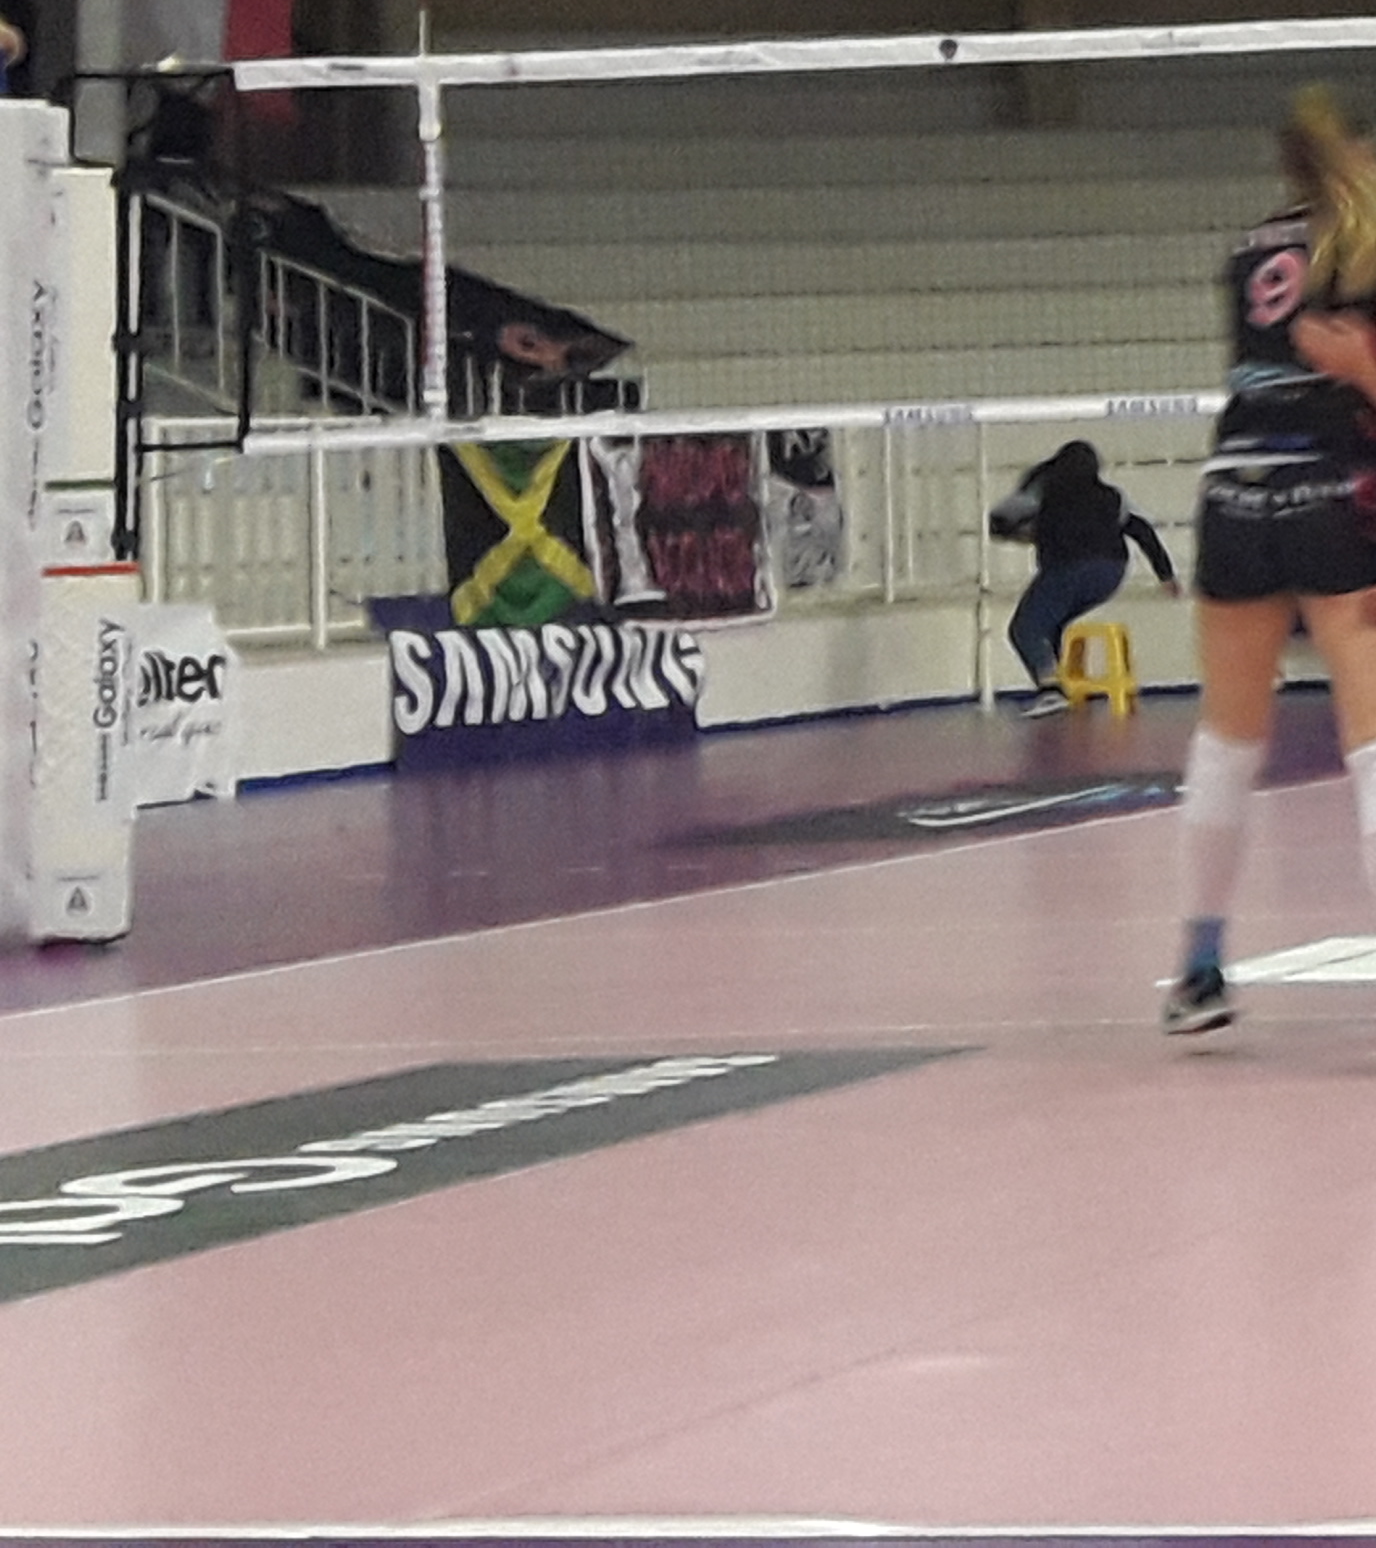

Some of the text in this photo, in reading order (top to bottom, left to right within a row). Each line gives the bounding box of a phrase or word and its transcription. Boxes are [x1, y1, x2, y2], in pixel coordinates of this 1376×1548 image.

[1247, 251, 1301, 327] 9
[93, 618, 125, 729] Galaxy
[388, 622, 702, 736] SAMSUNG
